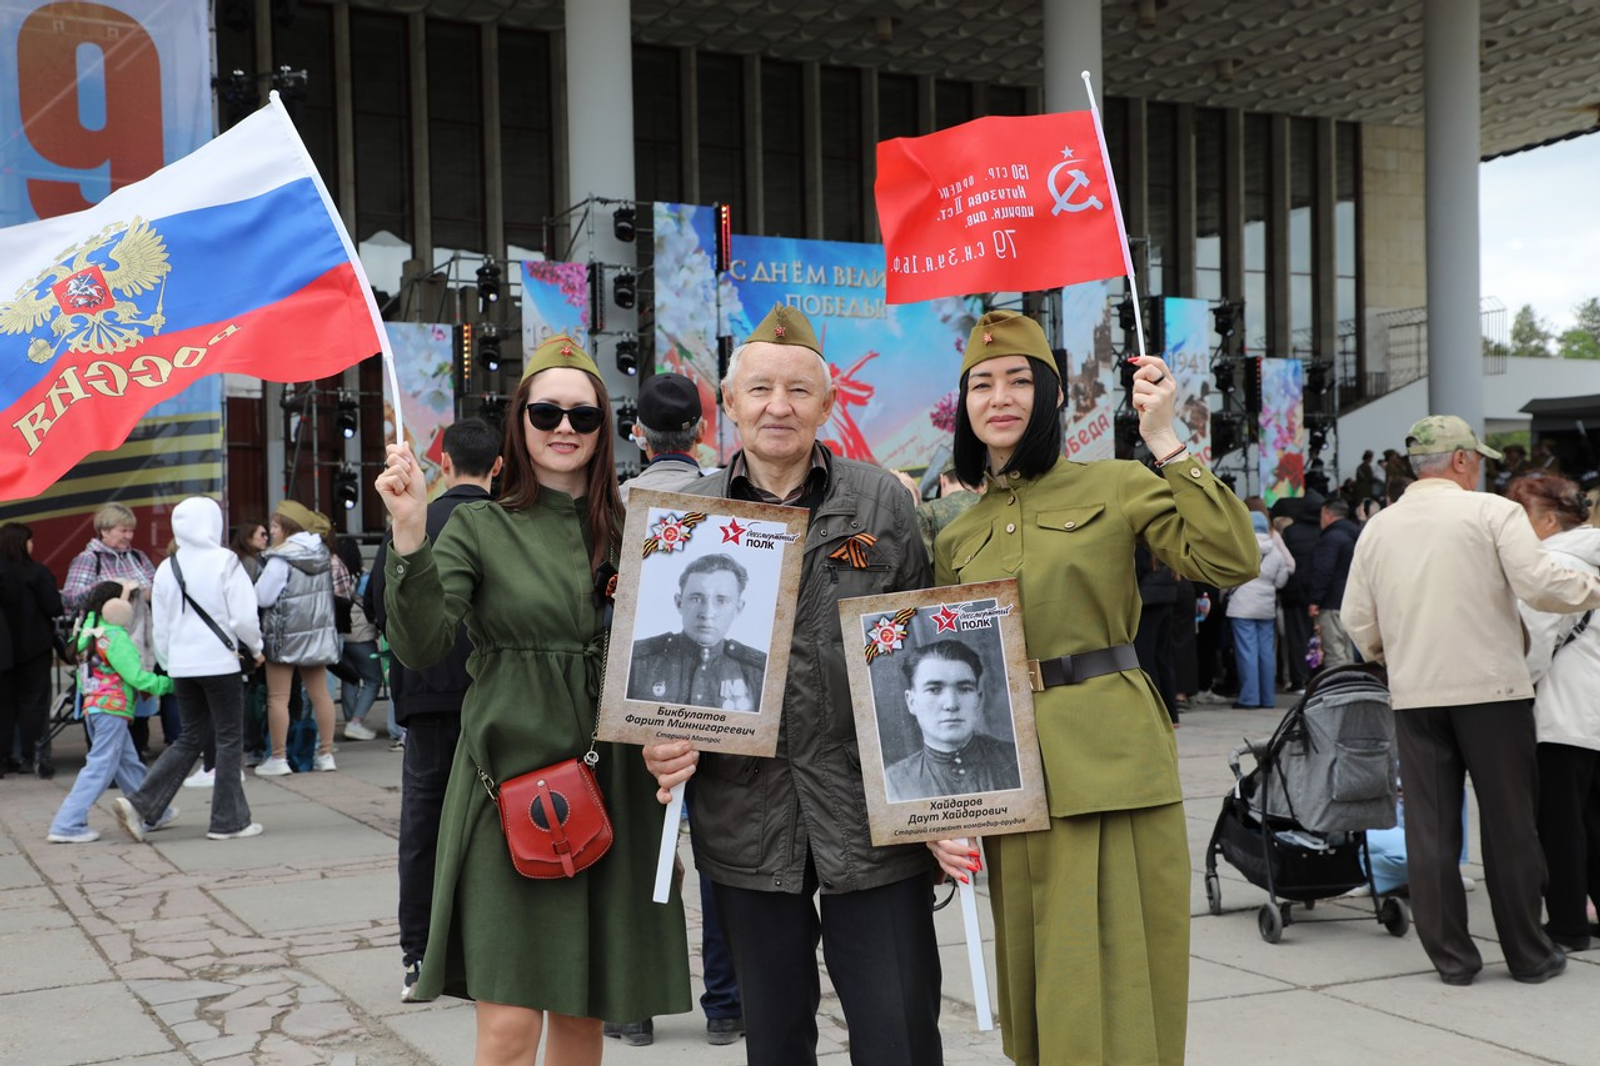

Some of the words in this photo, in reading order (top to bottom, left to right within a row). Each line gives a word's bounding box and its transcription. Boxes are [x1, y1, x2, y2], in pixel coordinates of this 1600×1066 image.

[17, 2, 165, 220] 9
[730, 260, 747, 281] С
[751, 260, 828, 284] ДНЁМ
[1168, 352, 1208, 374] 1941
[746, 539, 775, 550] ПОЛК
[961, 619, 991, 630] ПОЛК
[657, 706, 727, 722] Бикбулатов
[625, 714, 665, 727] Фарит
[667, 718, 756, 736] Миннигареевич
[930, 798, 983, 811] Хайдаров
[908, 814, 939, 825] Даут
[942, 806, 1008, 821] Хайдарович
